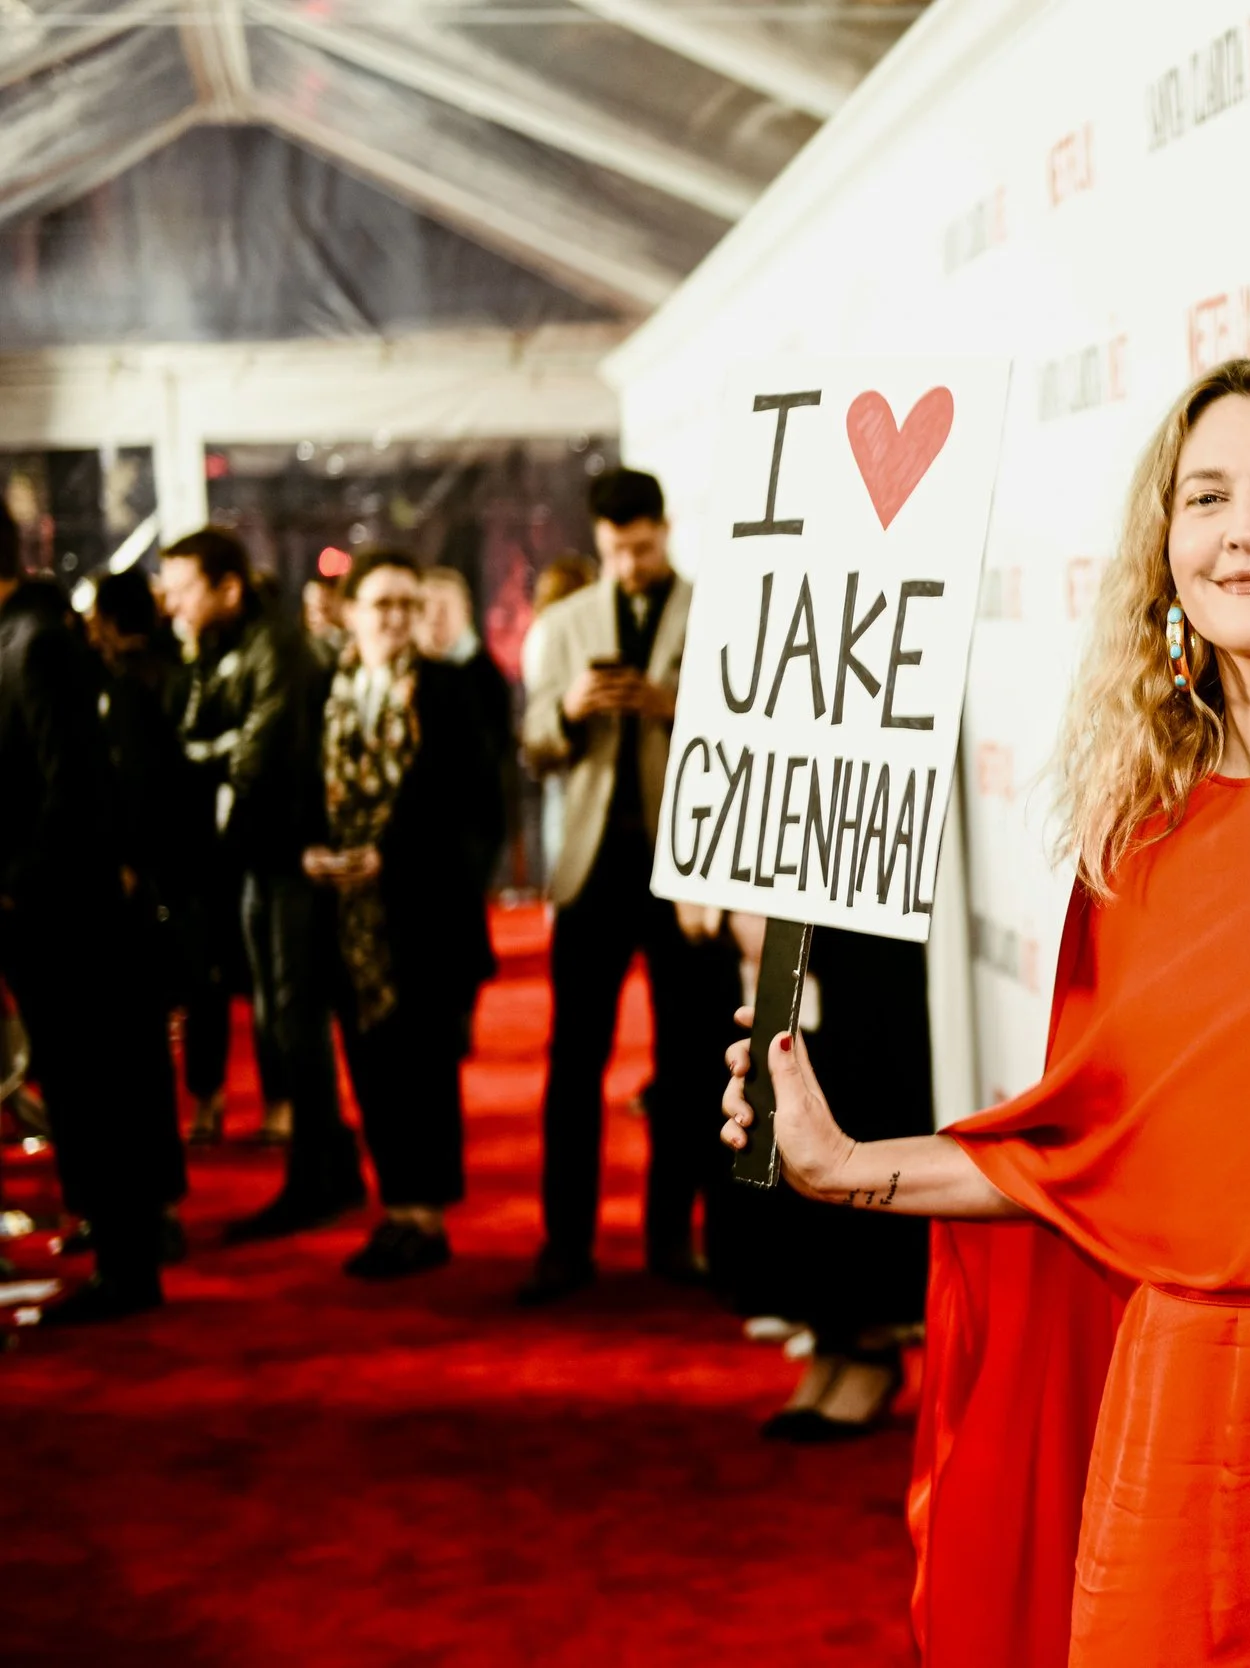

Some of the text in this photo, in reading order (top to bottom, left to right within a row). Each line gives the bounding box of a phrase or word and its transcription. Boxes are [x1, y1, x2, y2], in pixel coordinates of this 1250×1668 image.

[732, 389, 822, 539] I
[720, 571, 945, 731] JAKE
[671, 736, 937, 915] GYLLENHAAL
